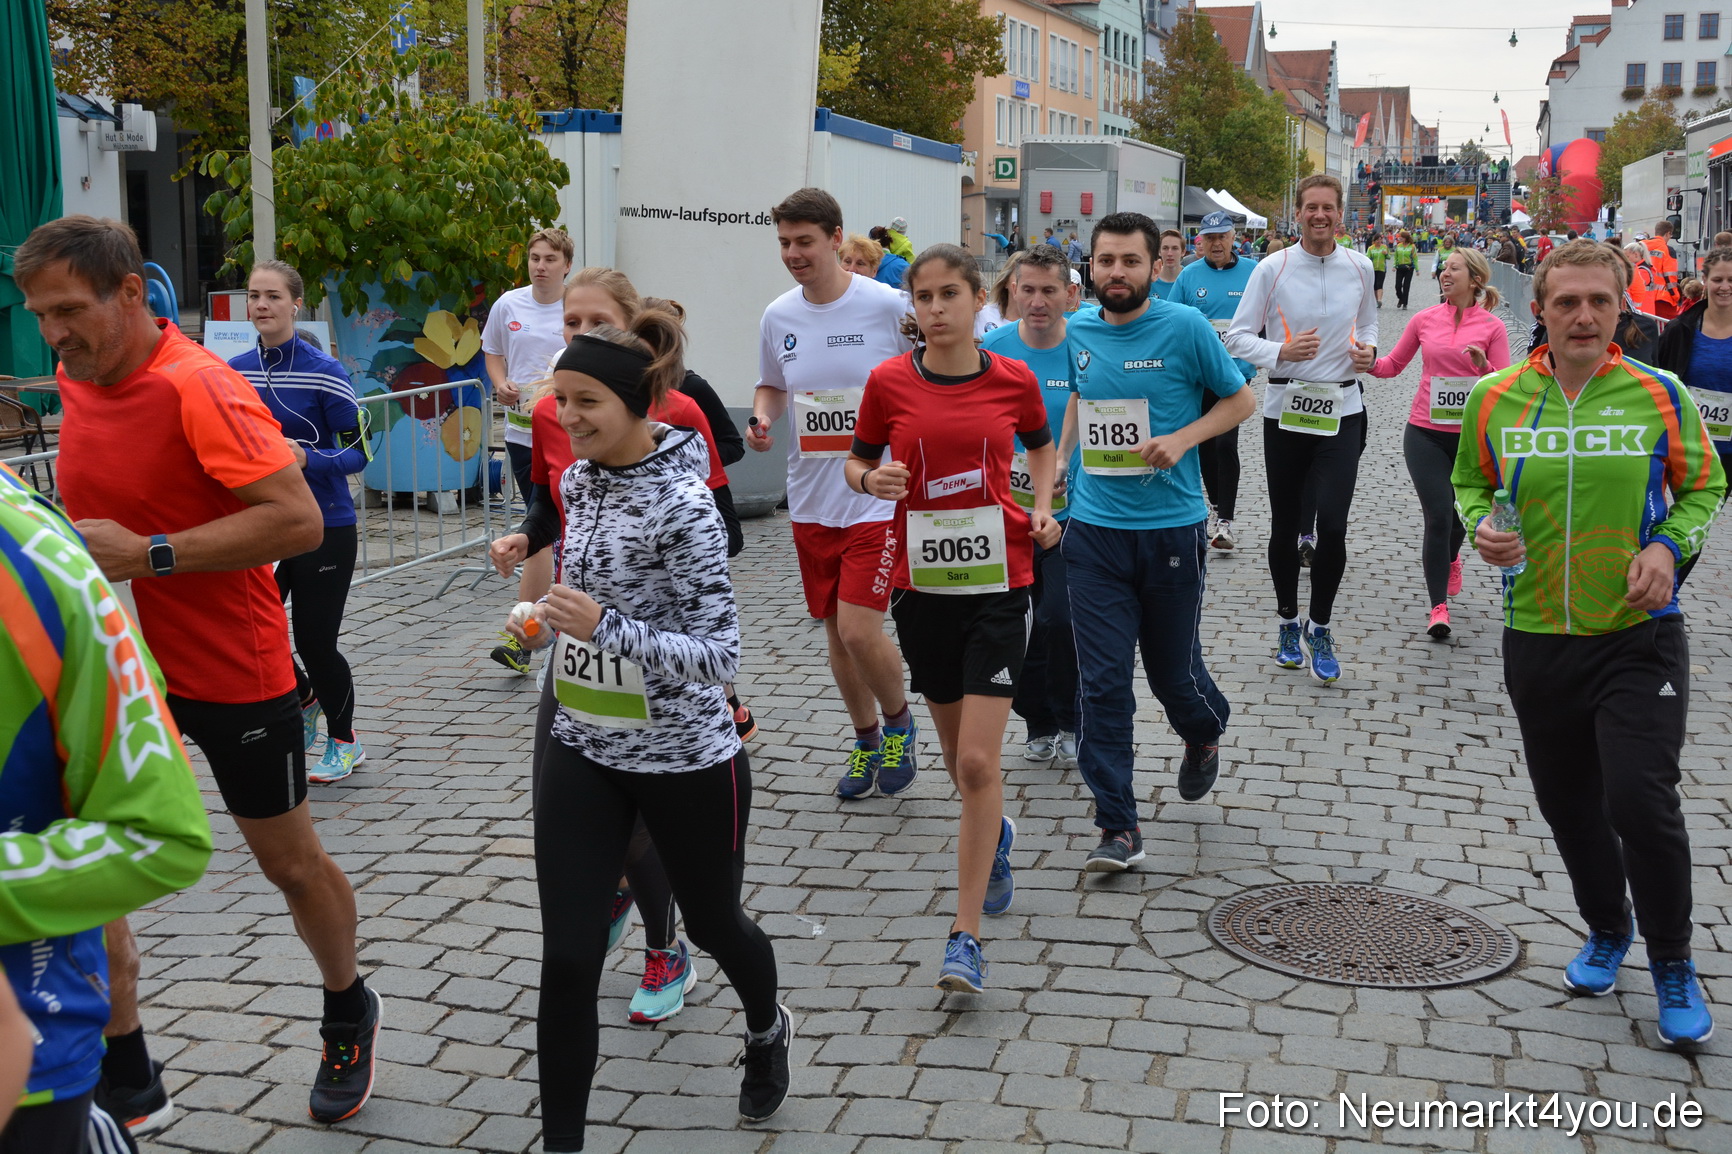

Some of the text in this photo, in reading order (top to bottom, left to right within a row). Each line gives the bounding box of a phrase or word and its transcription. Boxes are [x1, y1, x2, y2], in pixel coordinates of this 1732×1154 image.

[105, 133, 117, 141] Hut
[126, 133, 144, 141] Mode
[998, 160, 1014, 176] D
[1419, 186, 1441, 195] ZIEL
[619, 203, 773, 226] www.bmw-laufsport.de
[827, 334, 865, 344] BOCK
[1123, 359, 1165, 370] BOCK
[820, 395, 845, 403] BOCK
[1291, 395, 1334, 415] 5028
[806, 410, 857, 432] 8005
[1299, 416, 1320, 426] Robert
[1088, 422, 1140, 447] 5183
[1501, 425, 1649, 458] BOCK
[1103, 453, 1124, 463] Khalil
[942, 478, 967, 491] DEHN
[1011, 470, 1036, 491] 52
[942, 516, 976, 526] BOCK
[922, 535, 991, 563] 5063
[871, 526, 898, 596] SEASPORT
[947, 571, 969, 581] Sara
[20, 527, 173, 783] BOCK
[564, 642, 623, 687] 5211
[990, 676, 1013, 686] adidas
